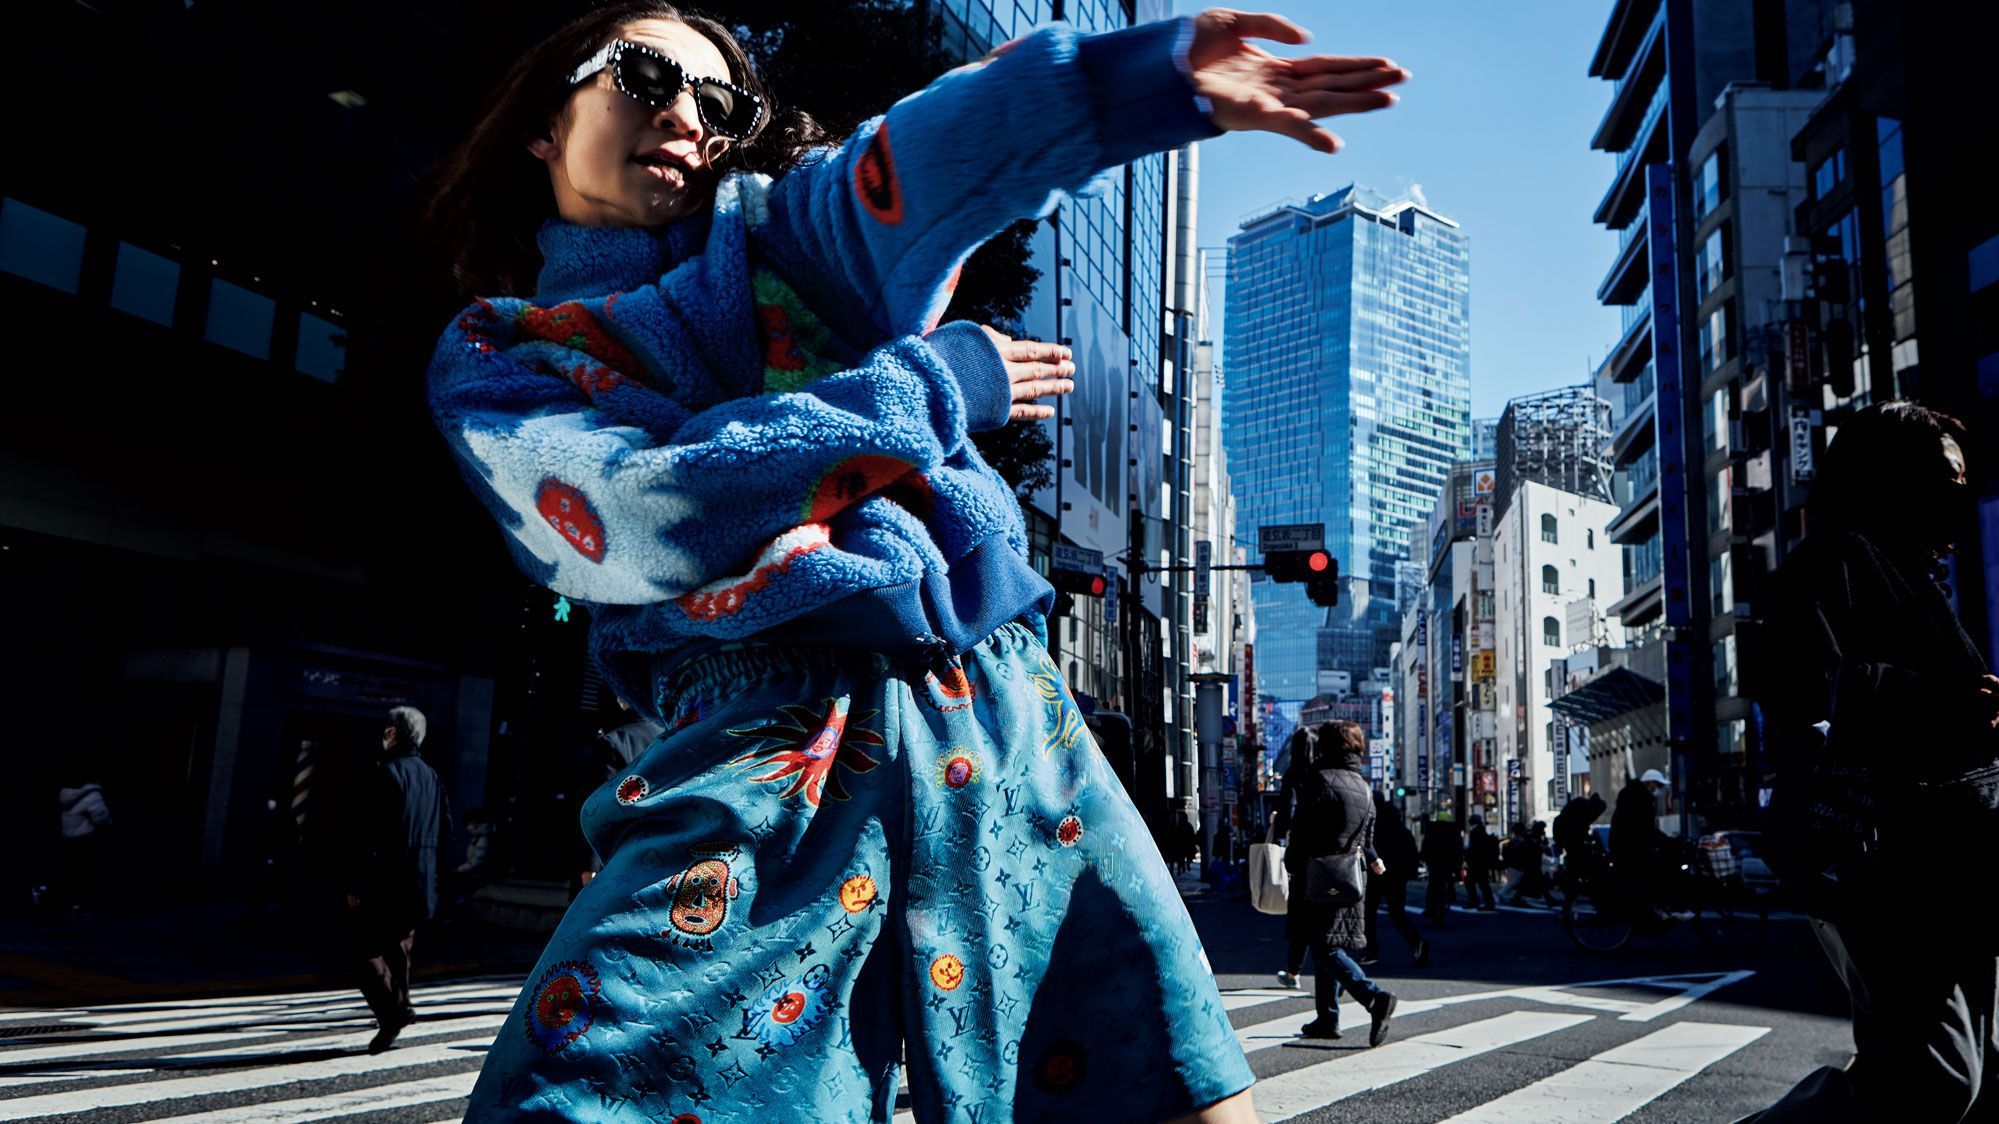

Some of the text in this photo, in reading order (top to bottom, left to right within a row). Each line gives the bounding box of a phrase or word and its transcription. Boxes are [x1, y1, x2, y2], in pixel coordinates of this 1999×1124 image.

[1263, 527, 1320, 541] 道玄坂二丁目
[947, 1003, 974, 1038] LV
